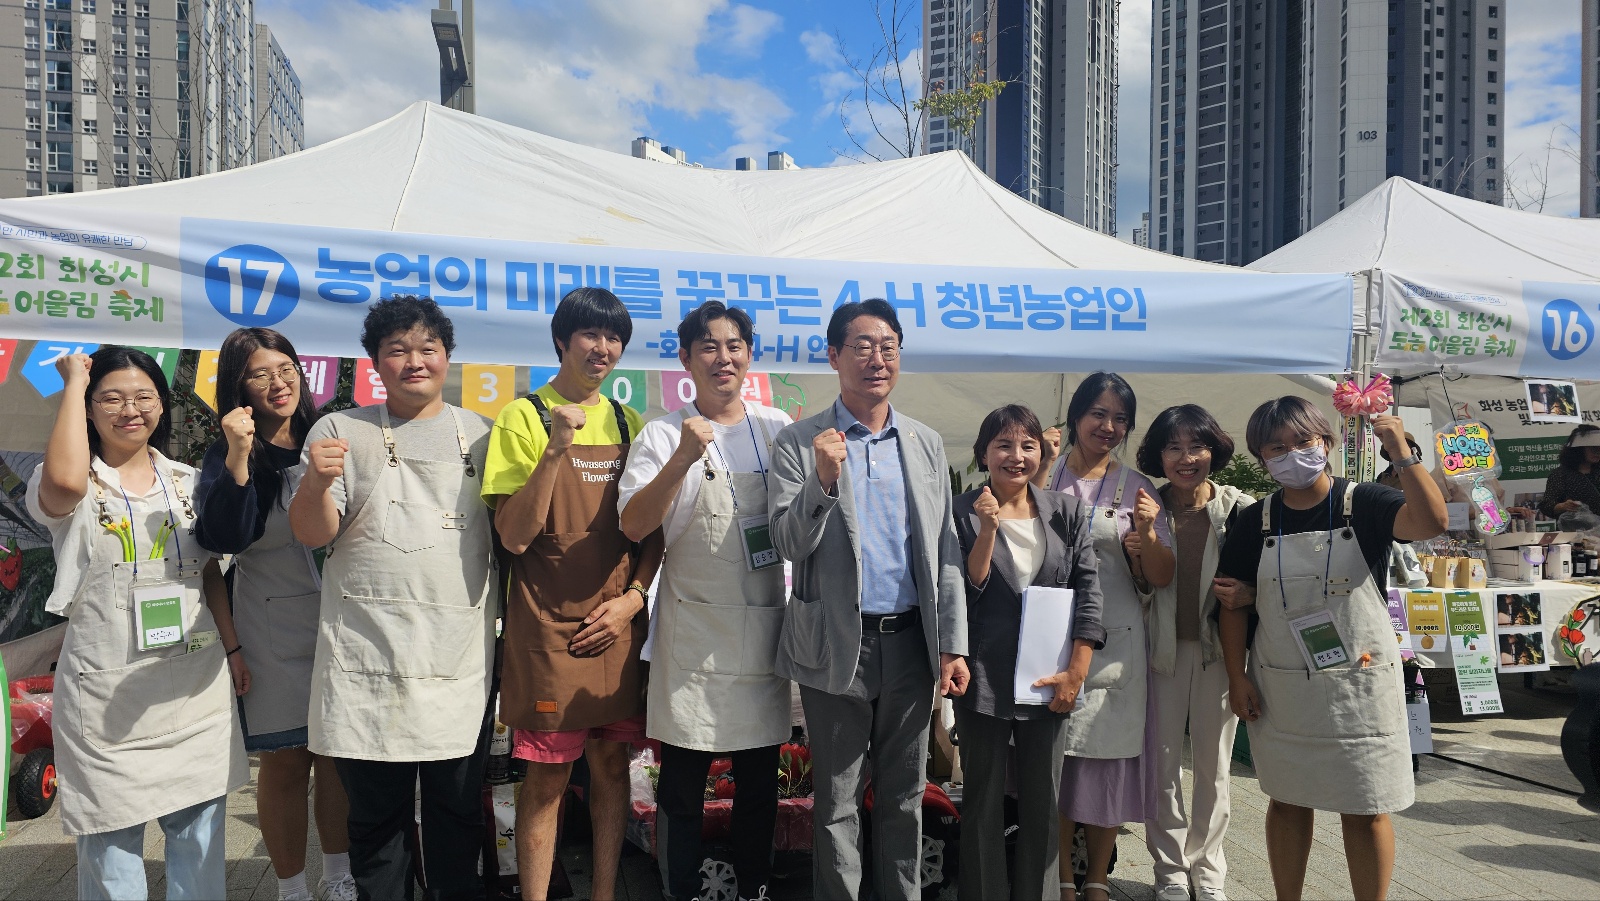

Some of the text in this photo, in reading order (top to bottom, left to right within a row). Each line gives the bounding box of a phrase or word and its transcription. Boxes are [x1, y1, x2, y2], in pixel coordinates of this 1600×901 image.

[1358, 130, 1378, 141] 103
[51, 231, 80, 243] 농업의
[81, 233, 111, 245] 유쾌한
[113, 236, 134, 247] 만남
[0, 251, 150, 288] 2회 화성시
[218, 257, 285, 316] 17
[314, 247, 488, 311] 농업의
[505, 261, 664, 320] 미래를
[676, 269, 823, 326] 꿈꾸는
[935, 281, 1147, 331] 청년농업인
[14, 289, 98, 319] 어울림
[107, 291, 164, 322] 축제
[1399, 306, 1513, 333] 제2회 화성시
[1545, 309, 1588, 353] 16
[1389, 331, 1517, 358] 도농 어울림 축제
[1477, 399, 1503, 412] 화성
[1442, 435, 1492, 457] 시원한
[571, 457, 621, 470] Hwaseong
[1443, 452, 1489, 471] 에이드
[1527, 464, 1545, 472] 화성시
[581, 471, 615, 483] Flower
